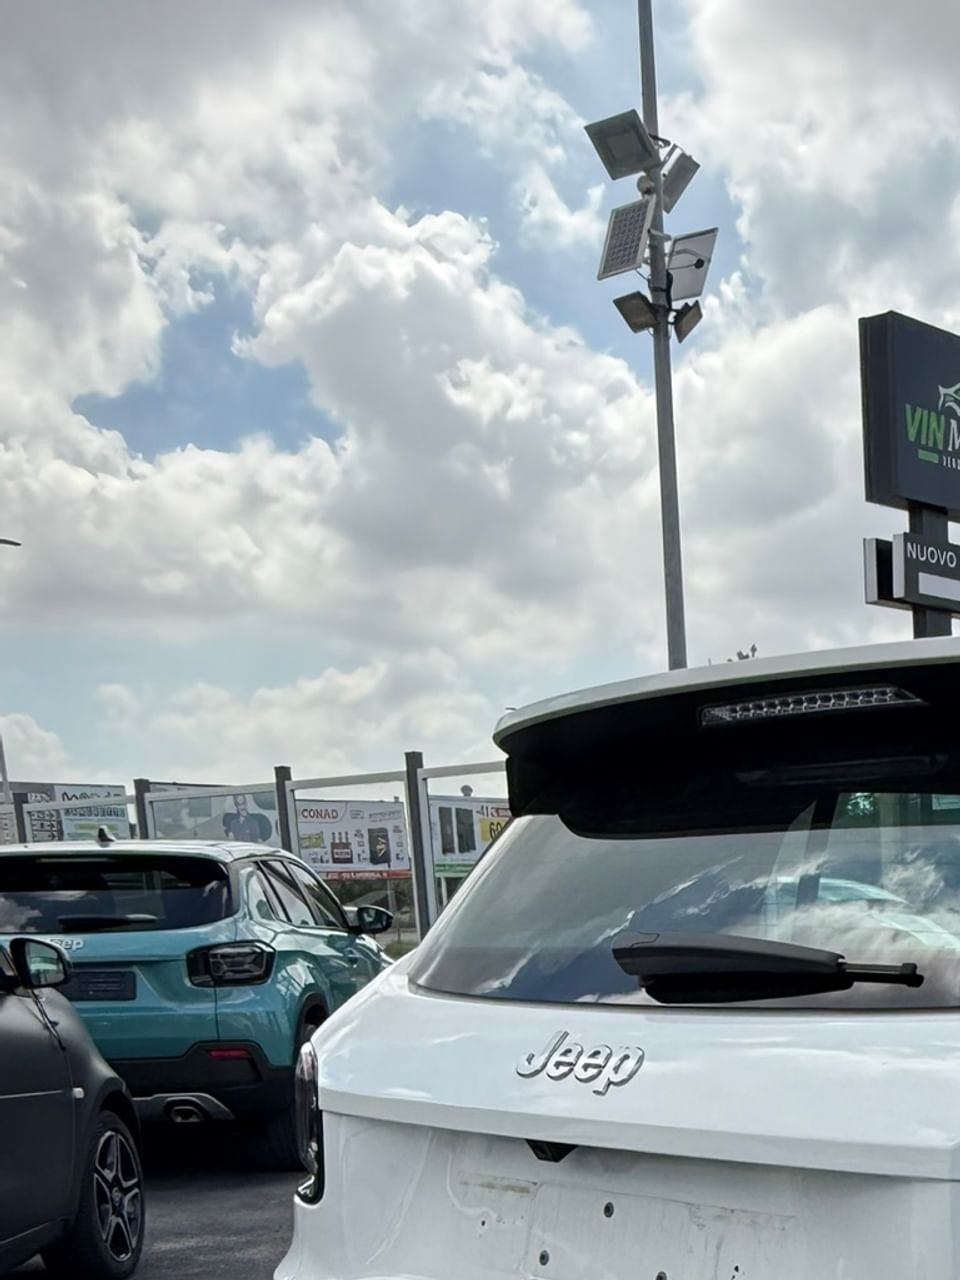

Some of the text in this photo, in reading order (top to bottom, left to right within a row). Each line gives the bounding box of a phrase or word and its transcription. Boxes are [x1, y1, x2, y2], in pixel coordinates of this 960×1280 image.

[906, 541, 957, 569] NUOVO
[301, 808, 339, 820] CONAD
[516, 1030, 645, 1096] Jeep
